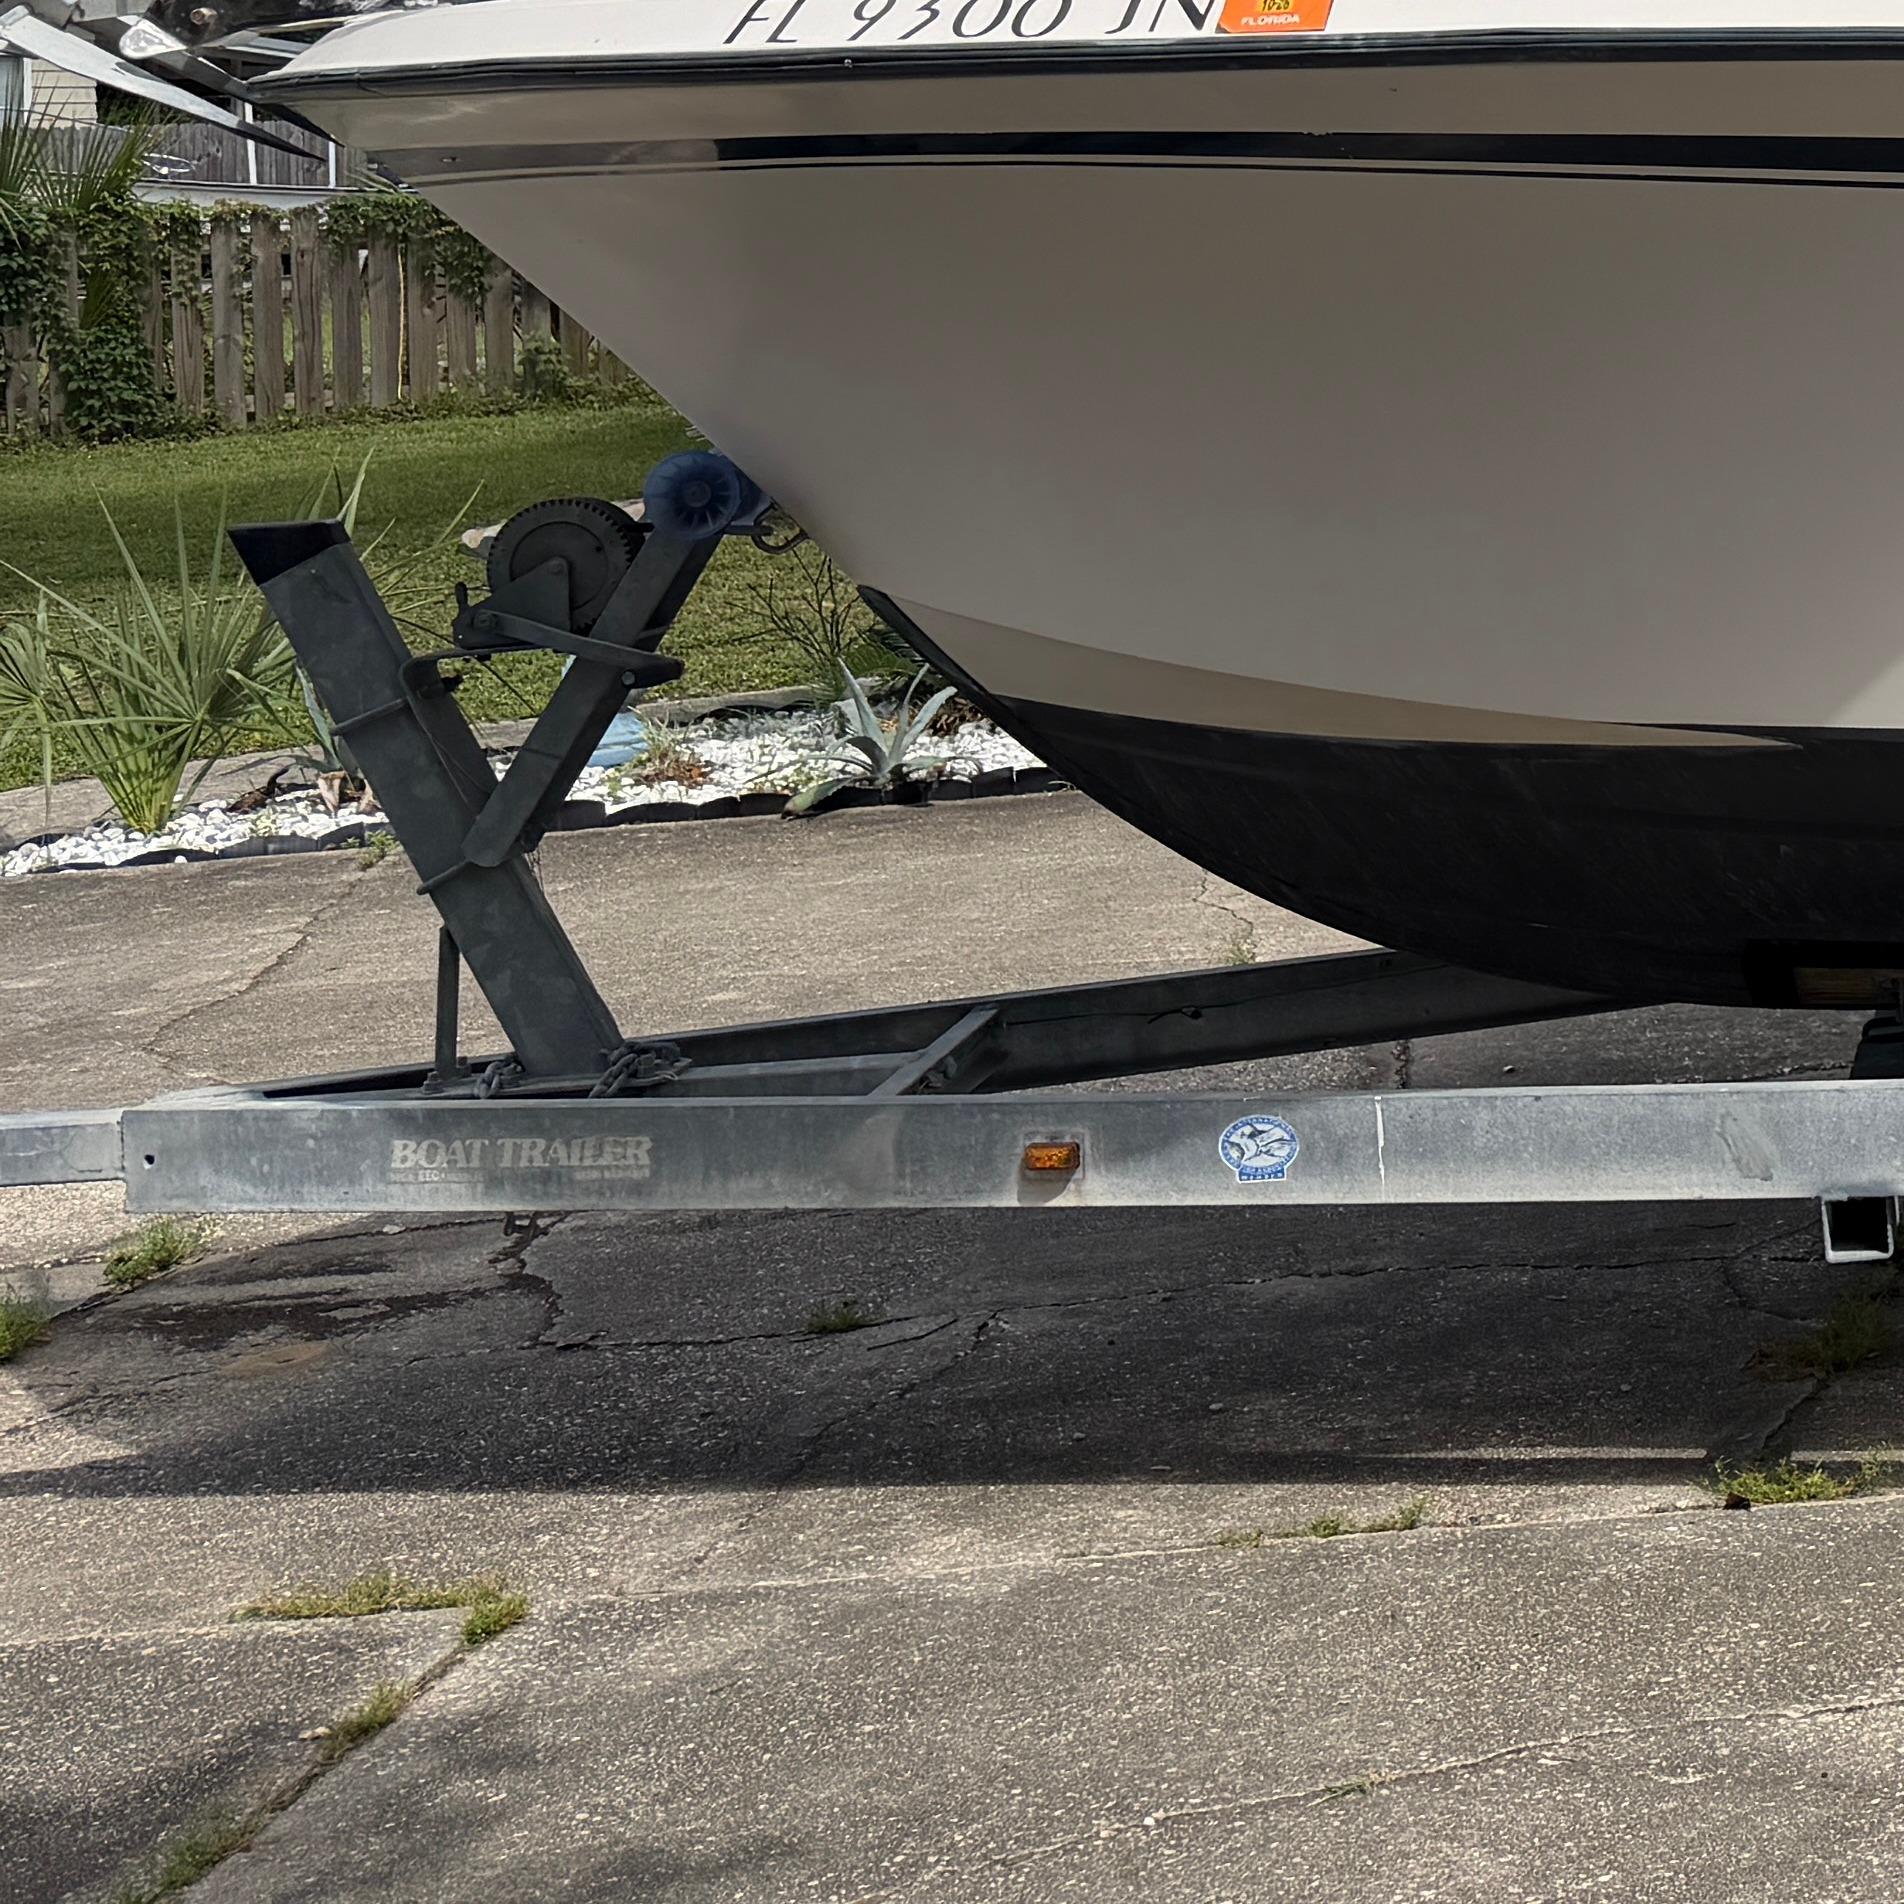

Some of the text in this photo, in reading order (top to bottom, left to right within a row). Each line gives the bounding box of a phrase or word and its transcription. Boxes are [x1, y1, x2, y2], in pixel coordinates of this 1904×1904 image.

[1240, 14, 1301, 26] FLORIDA
[390, 1136, 654, 1168] BOAT TRAILER
